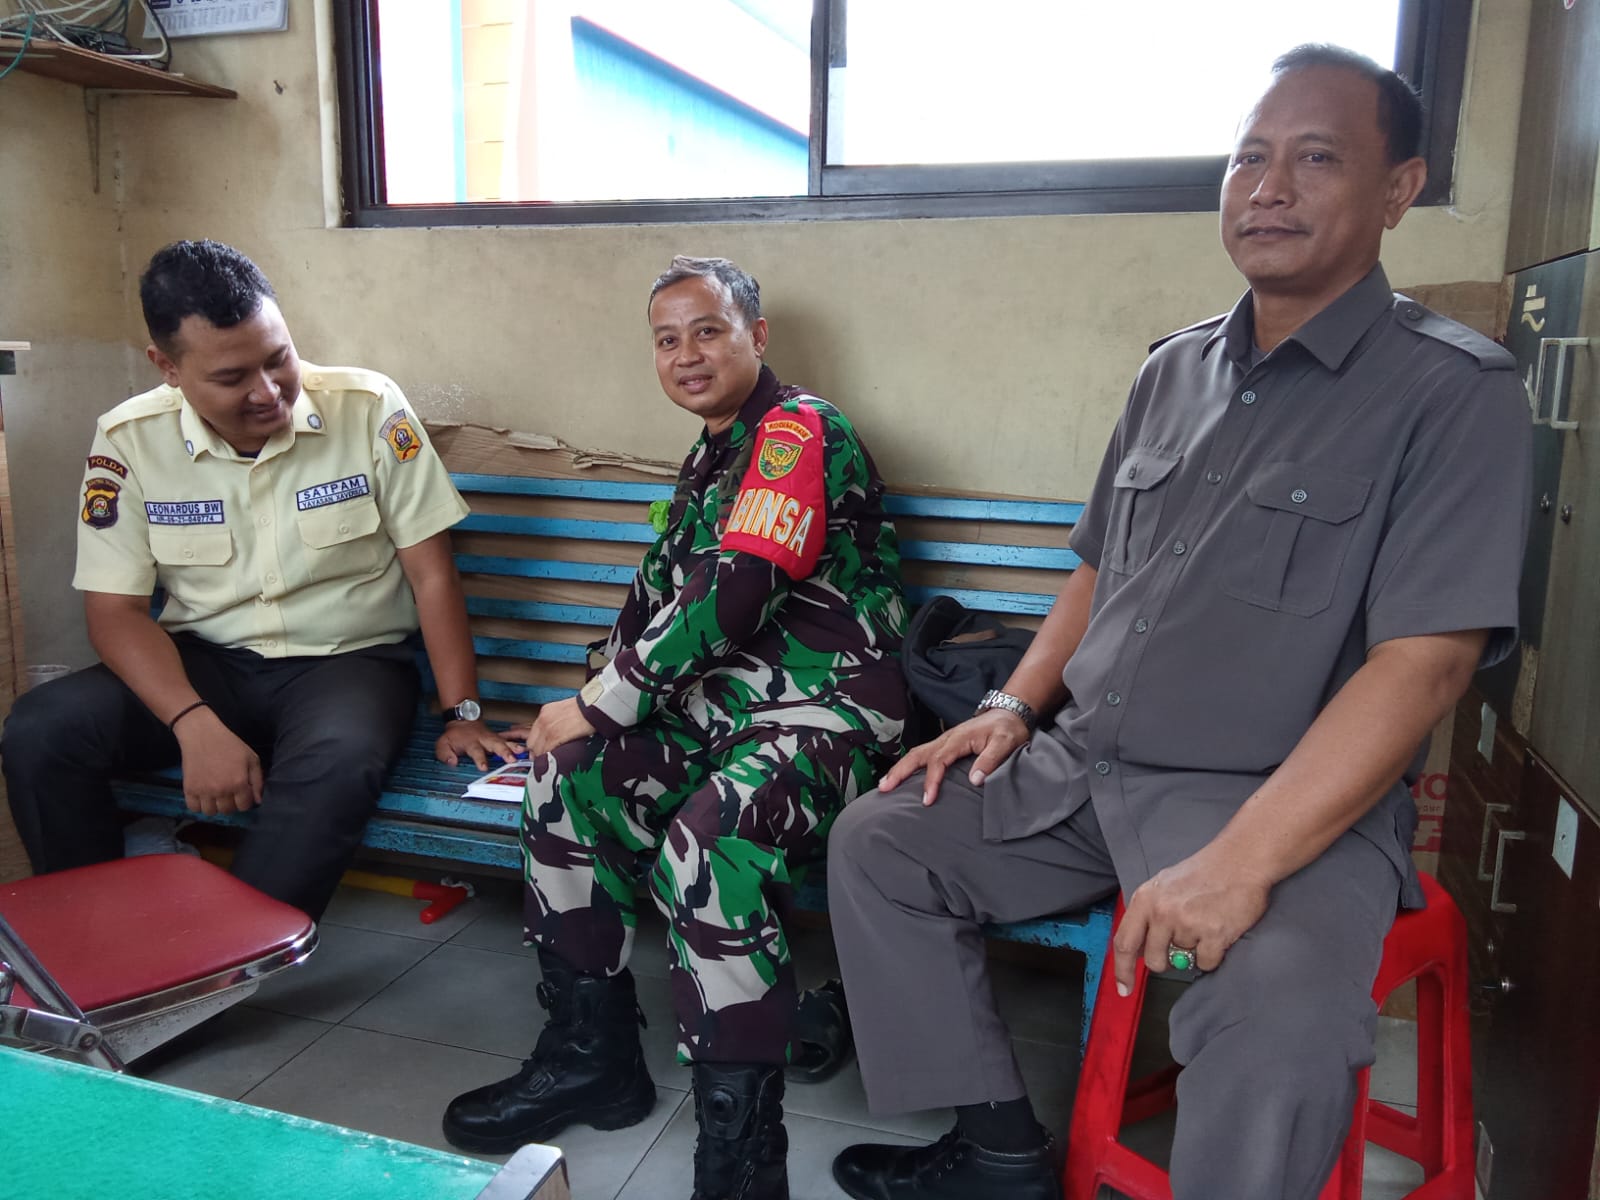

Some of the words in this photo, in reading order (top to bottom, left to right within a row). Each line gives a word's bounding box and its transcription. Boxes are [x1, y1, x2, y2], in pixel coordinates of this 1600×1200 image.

[90, 457, 125, 475] POLDA
[303, 478, 361, 500] SATPAM
[147, 502, 200, 515] LEONARDUS
[204, 502, 220, 514] BW
[725, 488, 815, 557] BINSA
